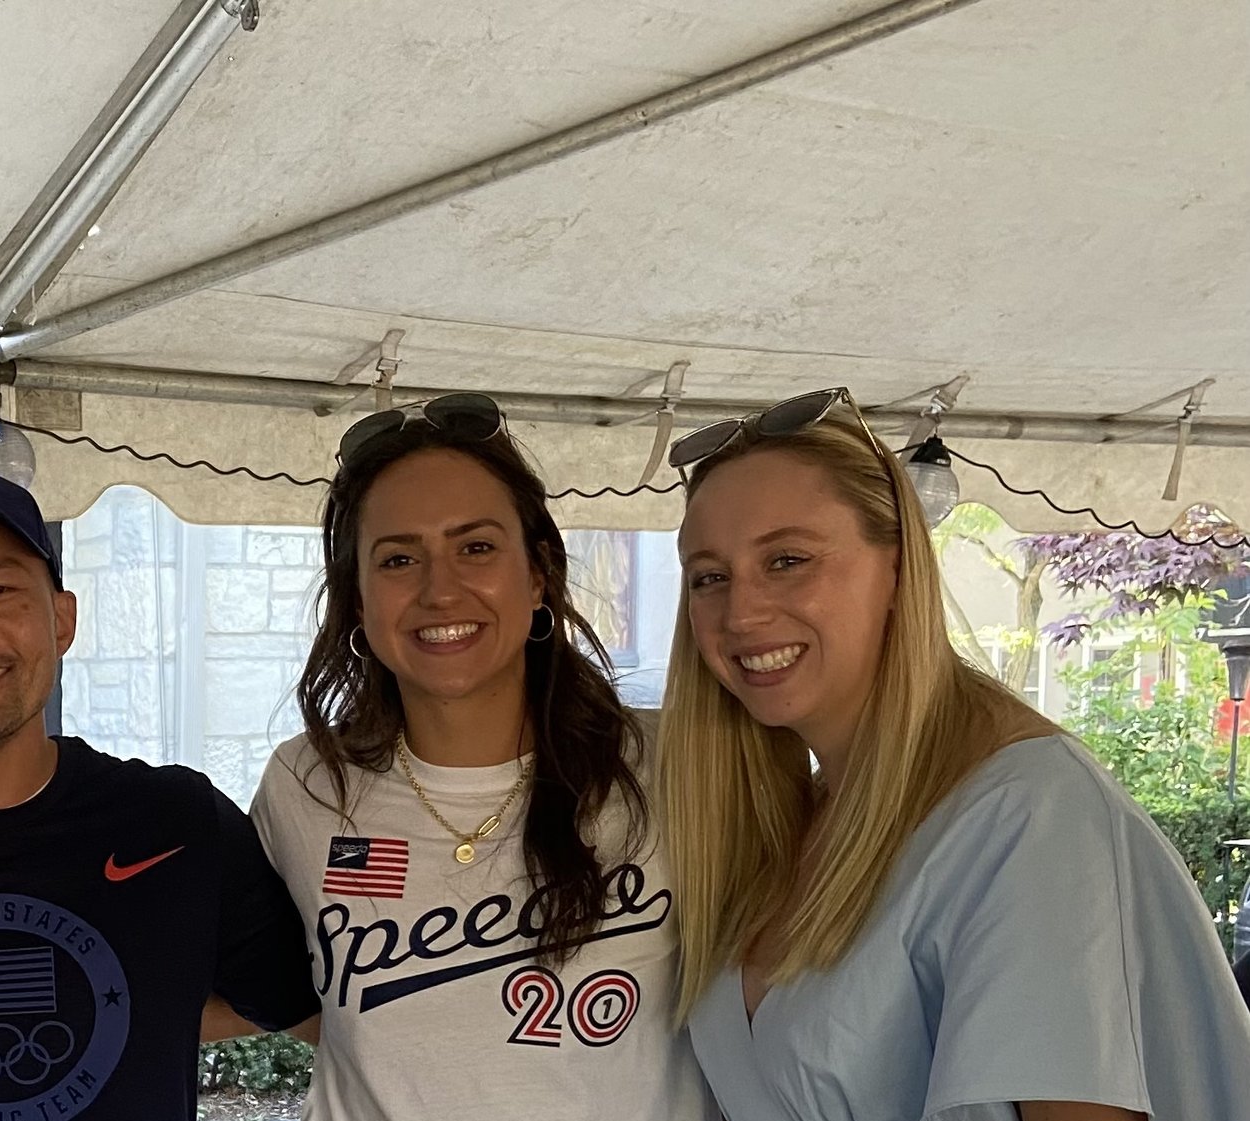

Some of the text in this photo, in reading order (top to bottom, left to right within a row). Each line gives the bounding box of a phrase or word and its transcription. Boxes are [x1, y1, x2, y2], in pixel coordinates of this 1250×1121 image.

[332, 843, 368, 854] speedo
[3, 901, 96, 955] STATES
[502, 965, 640, 1047] 20
